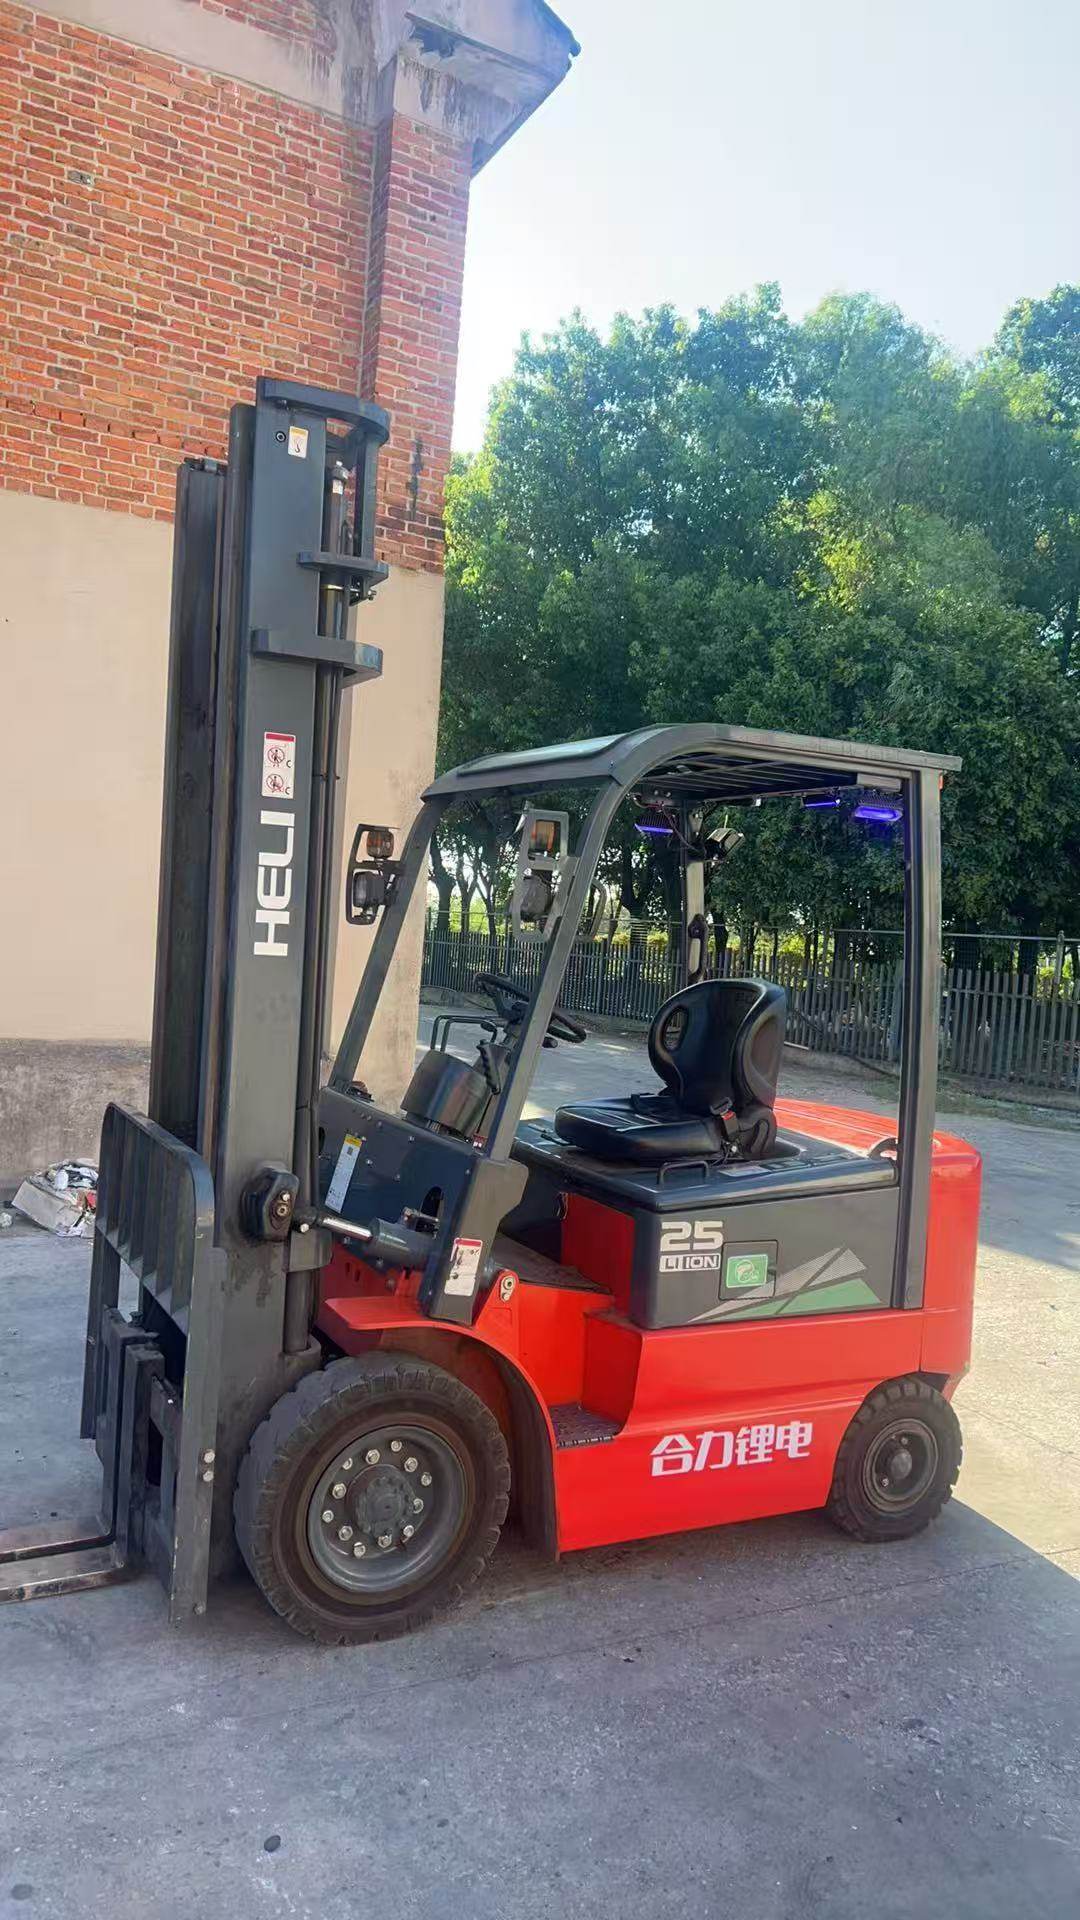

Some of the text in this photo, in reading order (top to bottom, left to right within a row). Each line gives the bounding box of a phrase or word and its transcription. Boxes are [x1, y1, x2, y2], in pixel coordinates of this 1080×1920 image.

[254, 810, 296, 957] HELI
[660, 1220, 724, 1252] 25
[650, 1420, 813, 1477] 合力锂电
